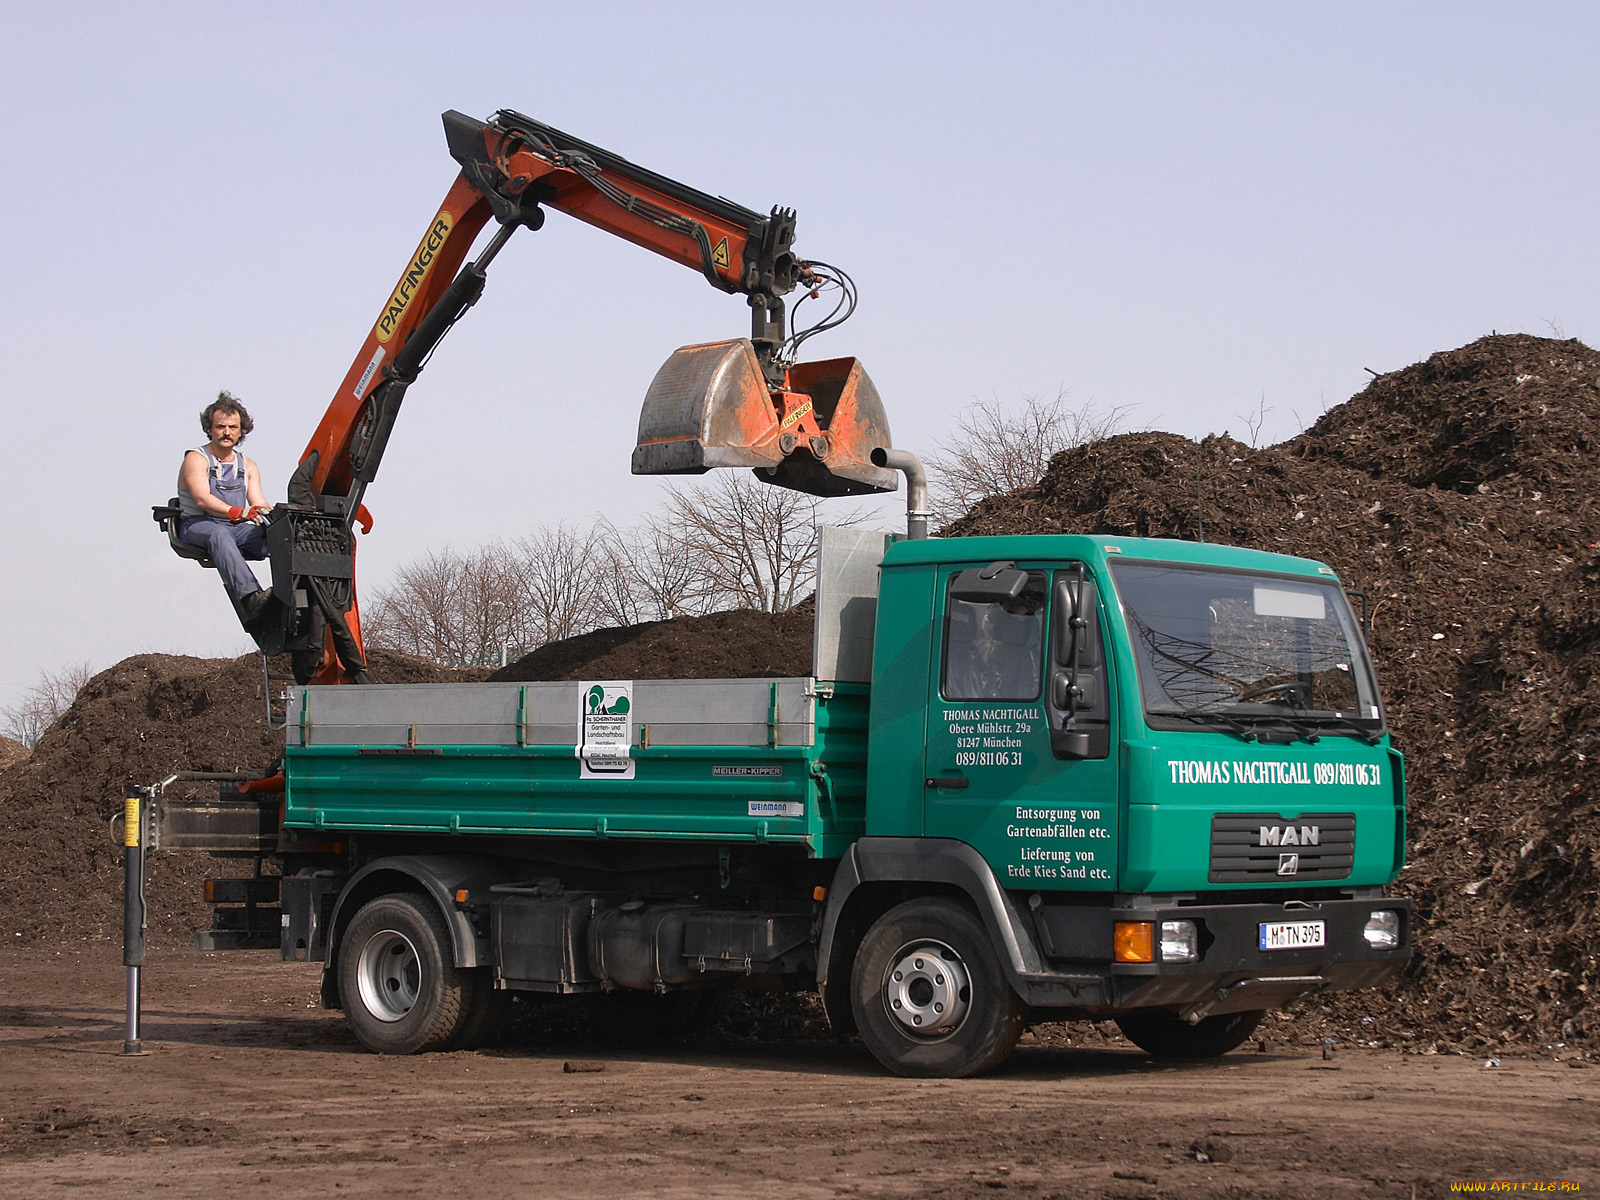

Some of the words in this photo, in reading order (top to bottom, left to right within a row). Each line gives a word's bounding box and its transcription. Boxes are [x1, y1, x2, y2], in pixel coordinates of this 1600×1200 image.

[379, 219, 449, 335] PALFINGER
[783, 402, 812, 427] PALFINGER
[942, 709, 980, 721] THOMAS
[982, 708, 1039, 720] NACHTIGALL
[949, 723, 974, 734] Obere
[976, 722, 1012, 734] Mühlstr.
[1015, 722, 1031, 733] 29a
[956, 737, 980, 748] 81247
[983, 736, 1022, 748] München
[955, 751, 994, 766] 089/811
[995, 751, 1009, 766] 06
[1011, 751, 1022, 766] 31
[713, 767, 781, 775] MEILLER-KIPPER
[1168, 760, 1231, 784] THOMAS
[1233, 761, 1311, 784] NACHTIGALL
[1313, 762, 1354, 785] 089/811
[1355, 763, 1368, 785] 06
[1370, 764, 1381, 785] 31
[1016, 806, 1077, 822] Entsorgung
[1080, 809, 1101, 820] von
[1006, 824, 1086, 838] Gartenabfällen
[1089, 827, 1111, 838] etc.
[1259, 825, 1320, 846] MAN
[1021, 847, 1071, 864] Lieferung
[1075, 851, 1095, 861] von
[1007, 864, 1031, 877] Erde
[1034, 865, 1057, 878] Kies
[1060, 865, 1086, 878] Sand
[1089, 868, 1111, 879] etc.
